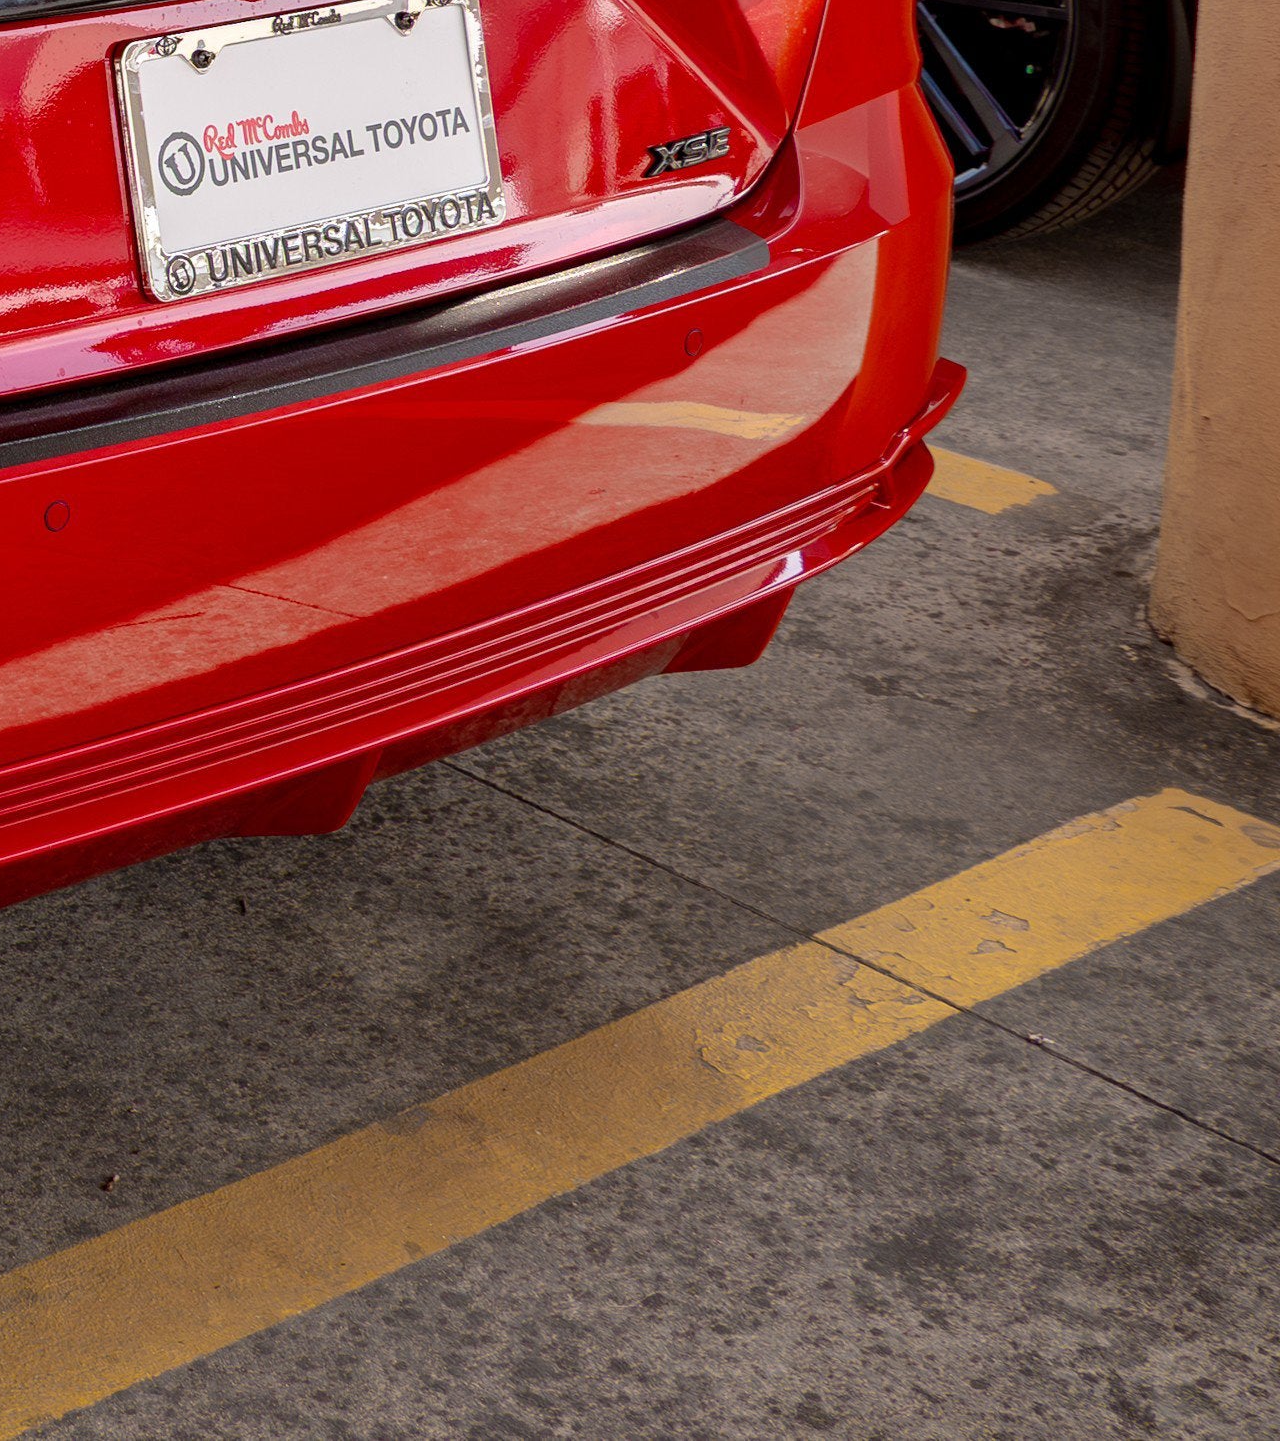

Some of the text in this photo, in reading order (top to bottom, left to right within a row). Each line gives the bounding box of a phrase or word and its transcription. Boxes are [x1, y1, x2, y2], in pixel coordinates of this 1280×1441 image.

[203, 110, 310, 161] Red McCombs
[208, 106, 471, 187] UNIVERSAL TOYOTA
[640, 126, 732, 178] XSE
[205, 190, 498, 283] UNIVERSAL TOYOTA
